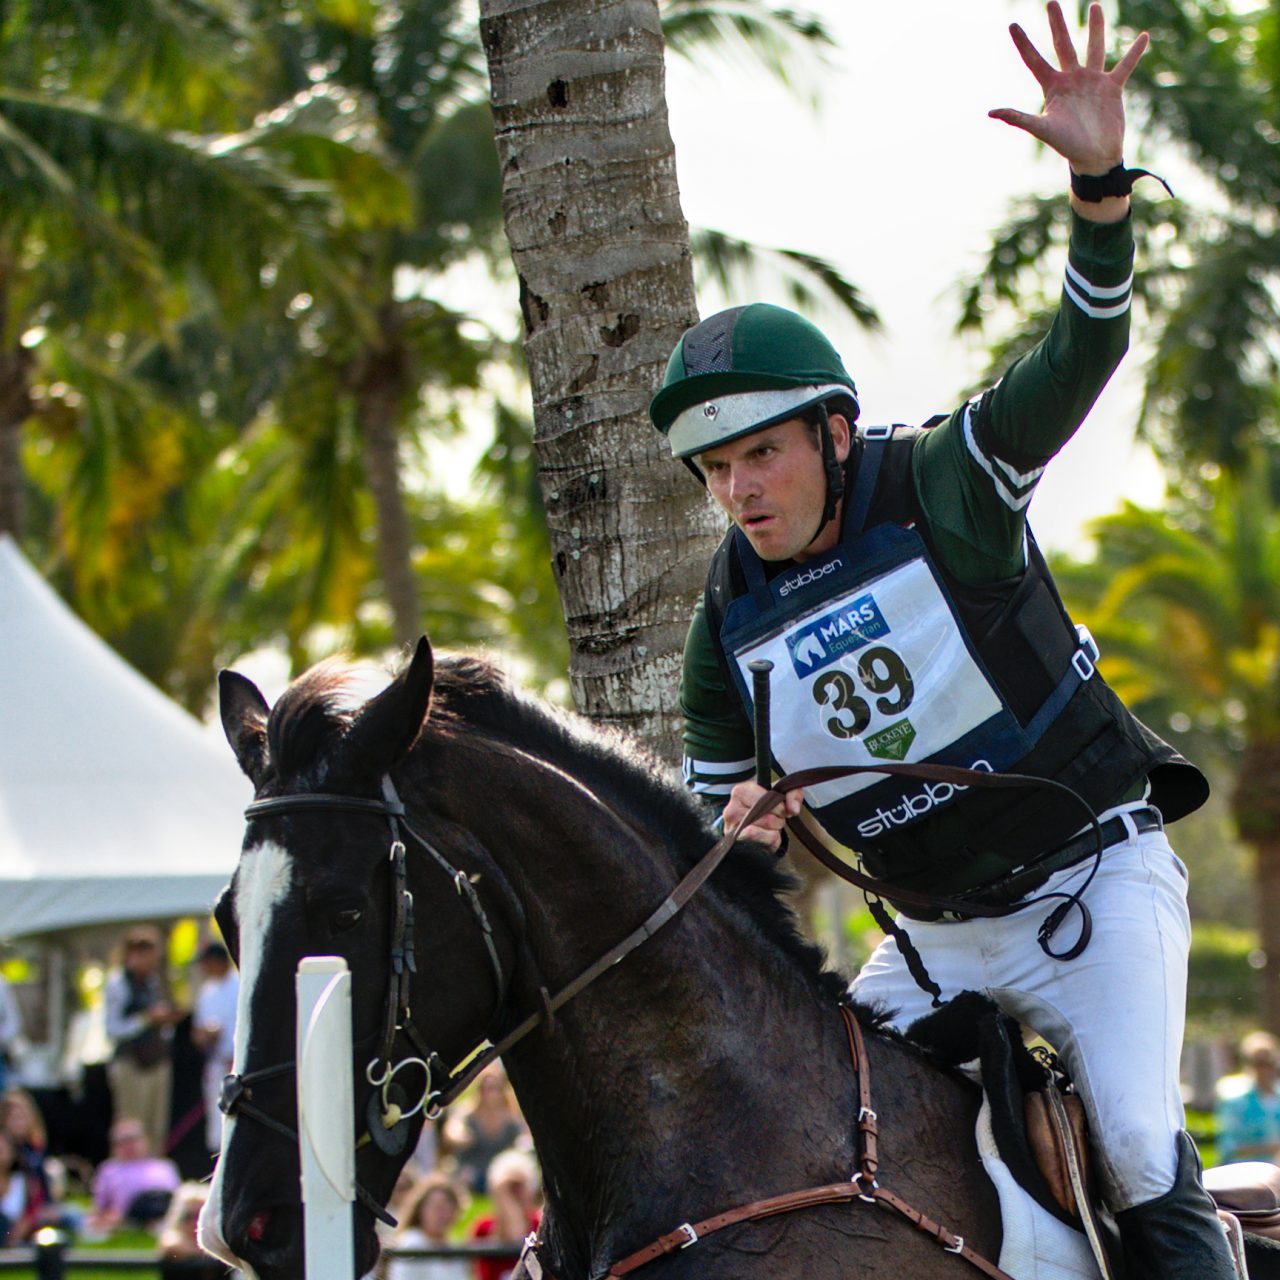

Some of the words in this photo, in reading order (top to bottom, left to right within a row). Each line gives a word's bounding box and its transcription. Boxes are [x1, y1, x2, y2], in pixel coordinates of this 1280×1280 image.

[779, 559, 843, 597] stübben
[819, 603, 875, 643] MARS
[812, 646, 915, 739] 39
[867, 722, 912, 751] BUCKEYE
